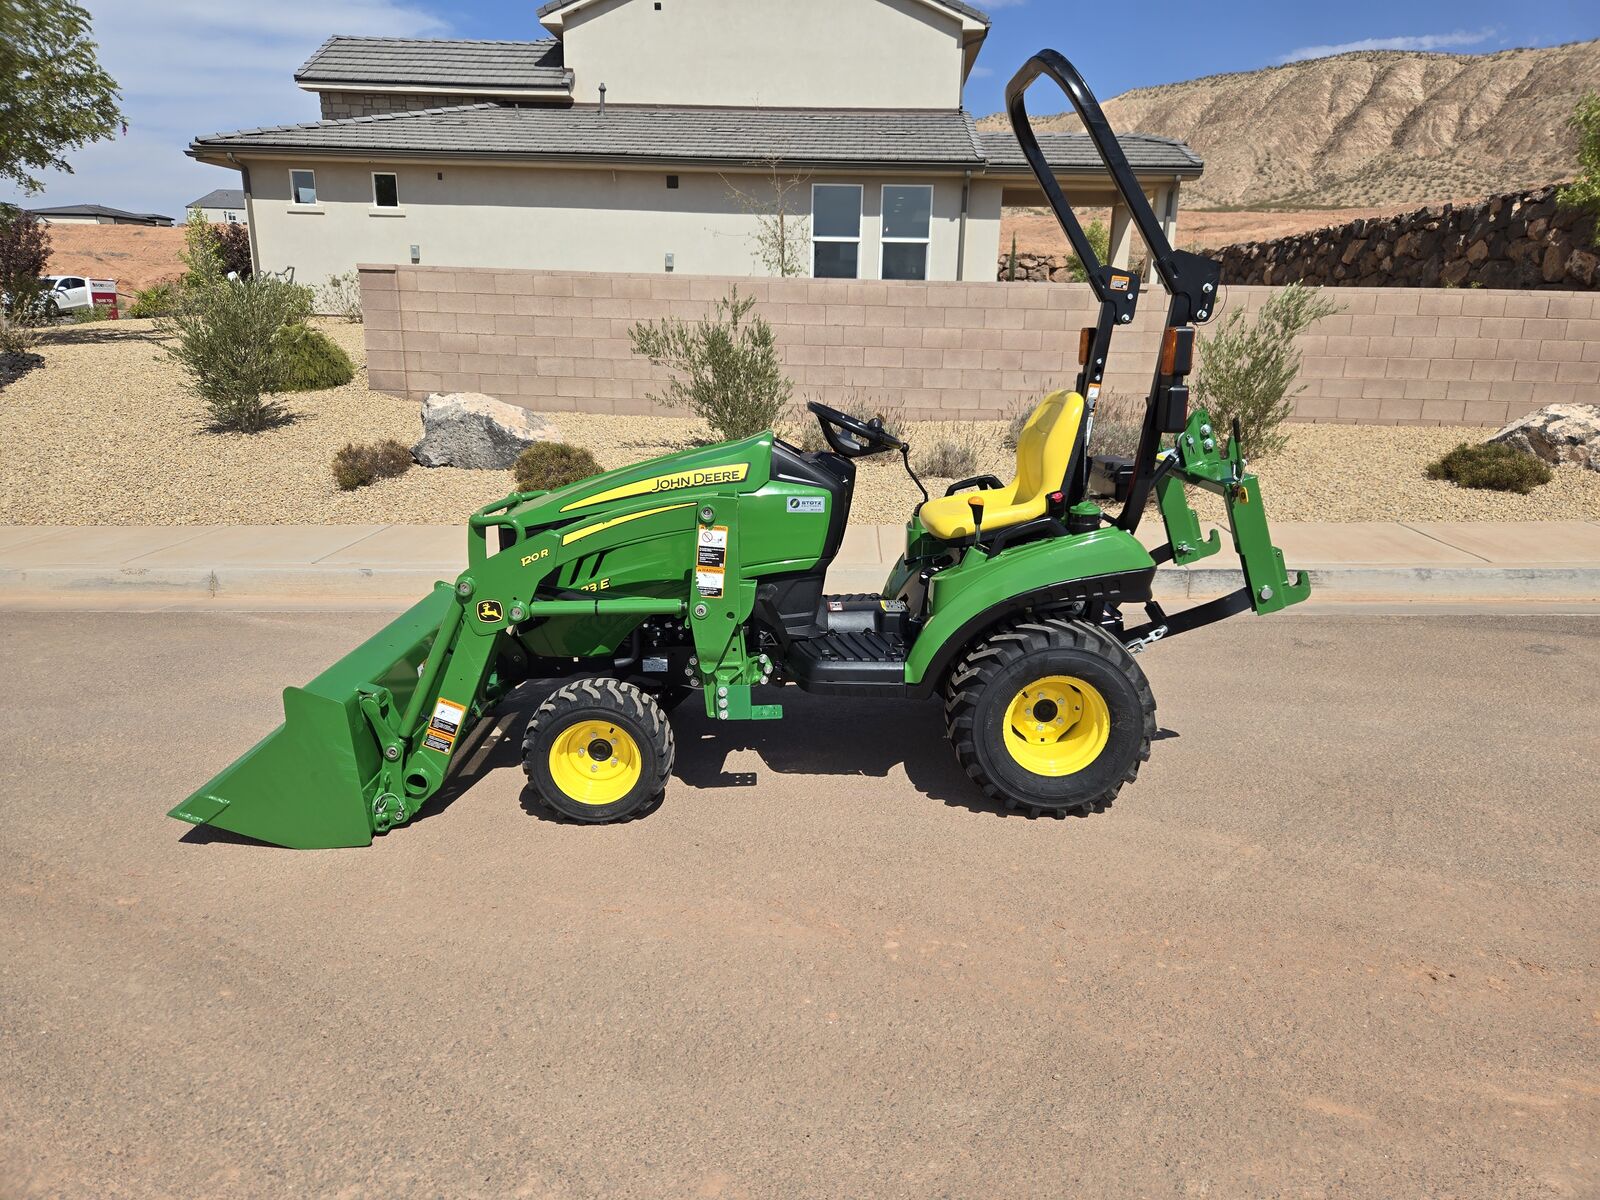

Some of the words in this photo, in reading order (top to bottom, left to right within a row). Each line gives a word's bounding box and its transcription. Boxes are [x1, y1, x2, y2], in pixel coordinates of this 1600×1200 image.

[652, 476, 690, 490] JOHN
[694, 470, 740, 484] DEERE
[540, 548, 548, 558] R
[600, 578, 610, 590] E
